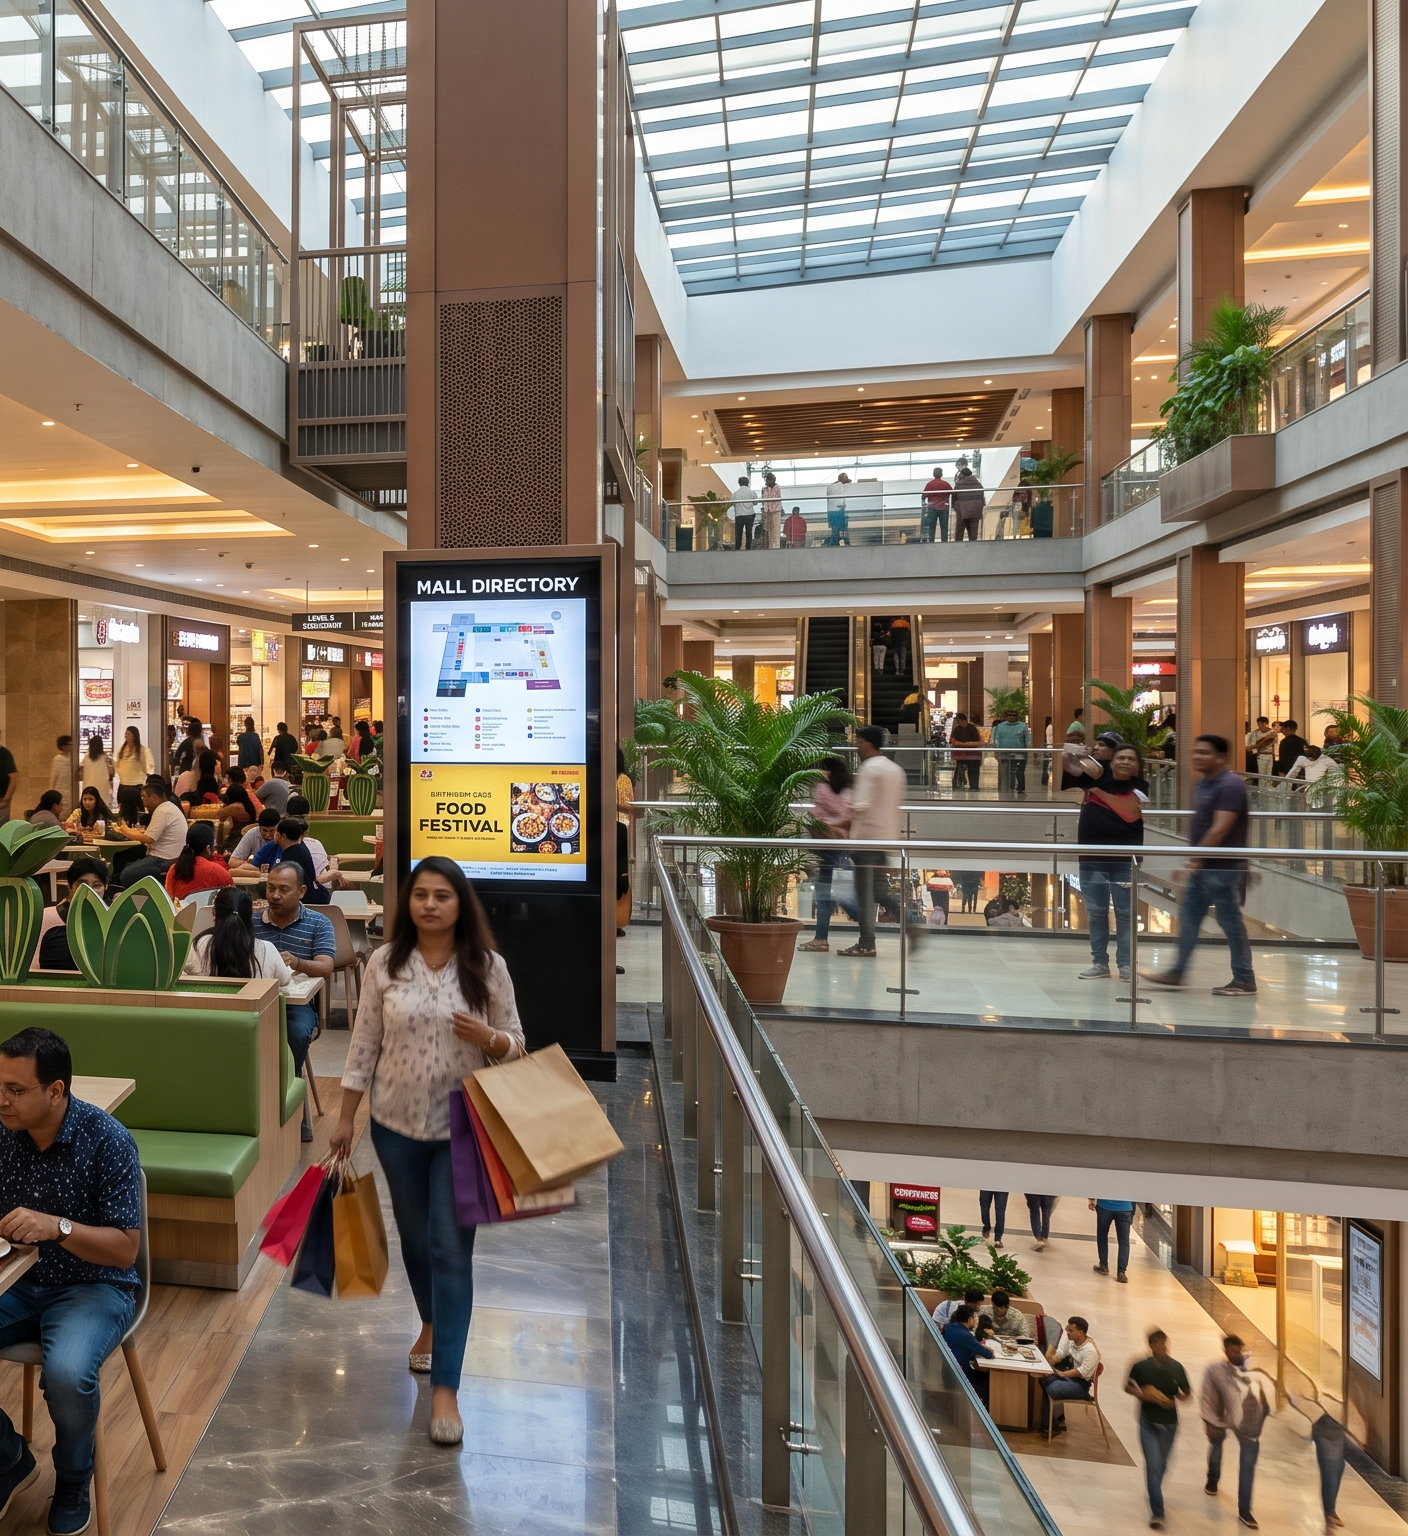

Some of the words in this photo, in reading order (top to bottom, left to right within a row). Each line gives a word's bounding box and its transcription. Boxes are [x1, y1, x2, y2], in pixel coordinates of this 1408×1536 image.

[417, 579, 467, 595] MALL
[472, 576, 580, 594] DIRECTORY
[436, 803, 486, 815] FOOD
[419, 819, 503, 832] FESTIVAL
